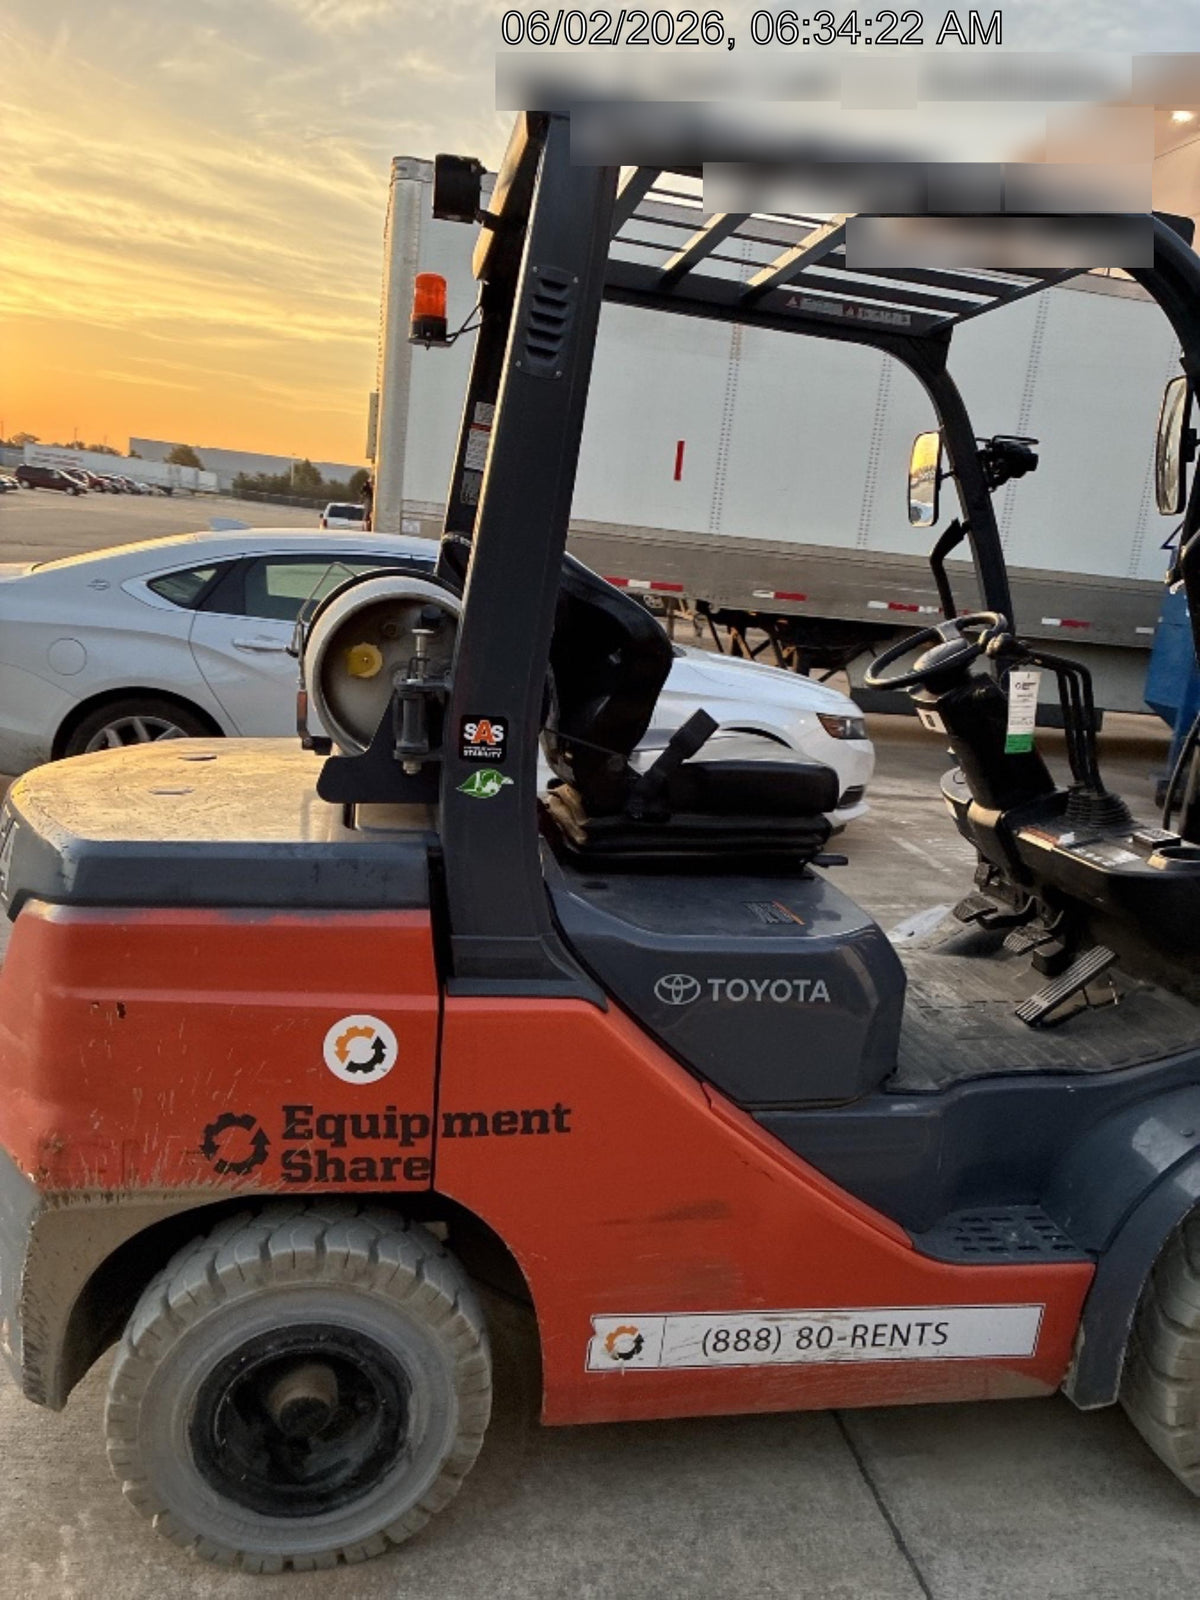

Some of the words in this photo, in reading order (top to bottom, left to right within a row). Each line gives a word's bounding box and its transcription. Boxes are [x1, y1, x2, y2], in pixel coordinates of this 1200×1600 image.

[463, 720, 504, 745] SAS
[707, 978, 831, 1003] TOYOTA
[281, 1102, 571, 1147] Equipment
[281, 1148, 430, 1183] Share
[701, 1326, 783, 1356] (888)
[795, 1321, 950, 1350] 80-RENTS
